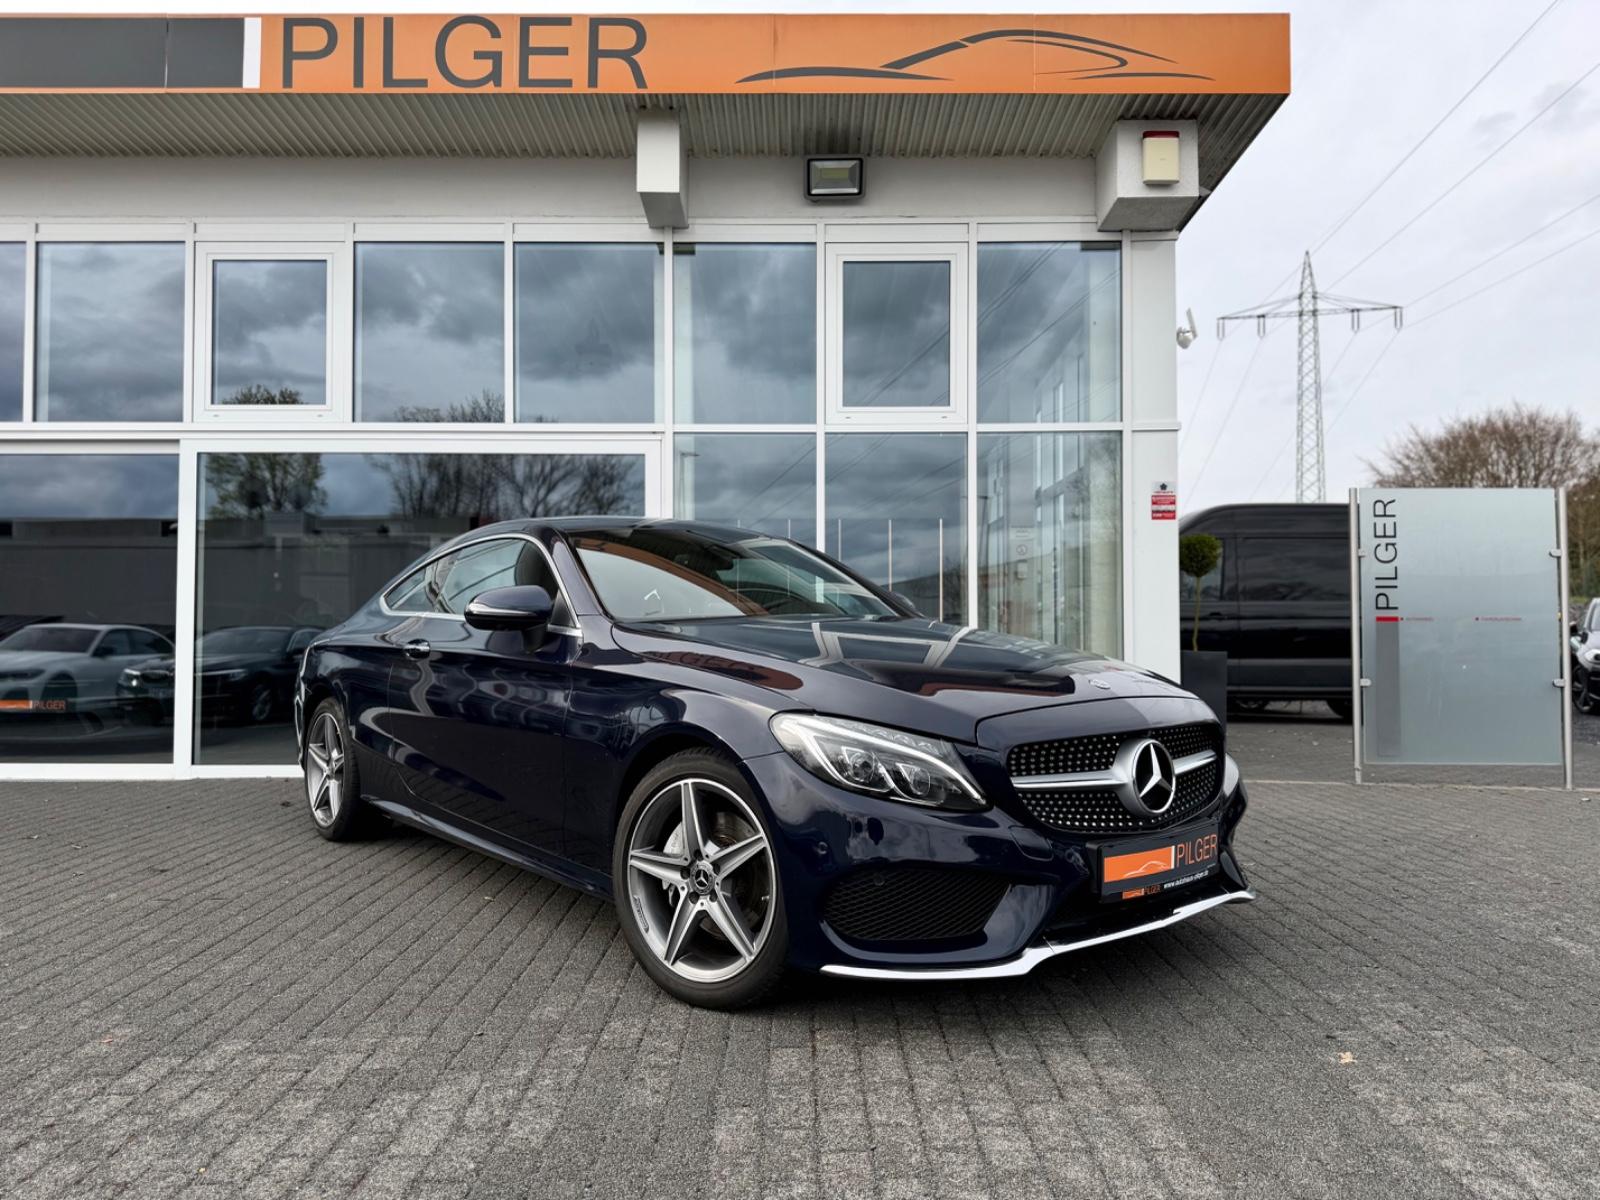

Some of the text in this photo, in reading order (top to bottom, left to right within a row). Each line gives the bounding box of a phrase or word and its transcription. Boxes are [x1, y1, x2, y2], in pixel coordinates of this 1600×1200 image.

[281, 15, 649, 89] PILGER
[1373, 499, 1399, 610] PILGER
[33, 700, 65, 710] PILGER
[1176, 834, 1218, 867] PILGER
